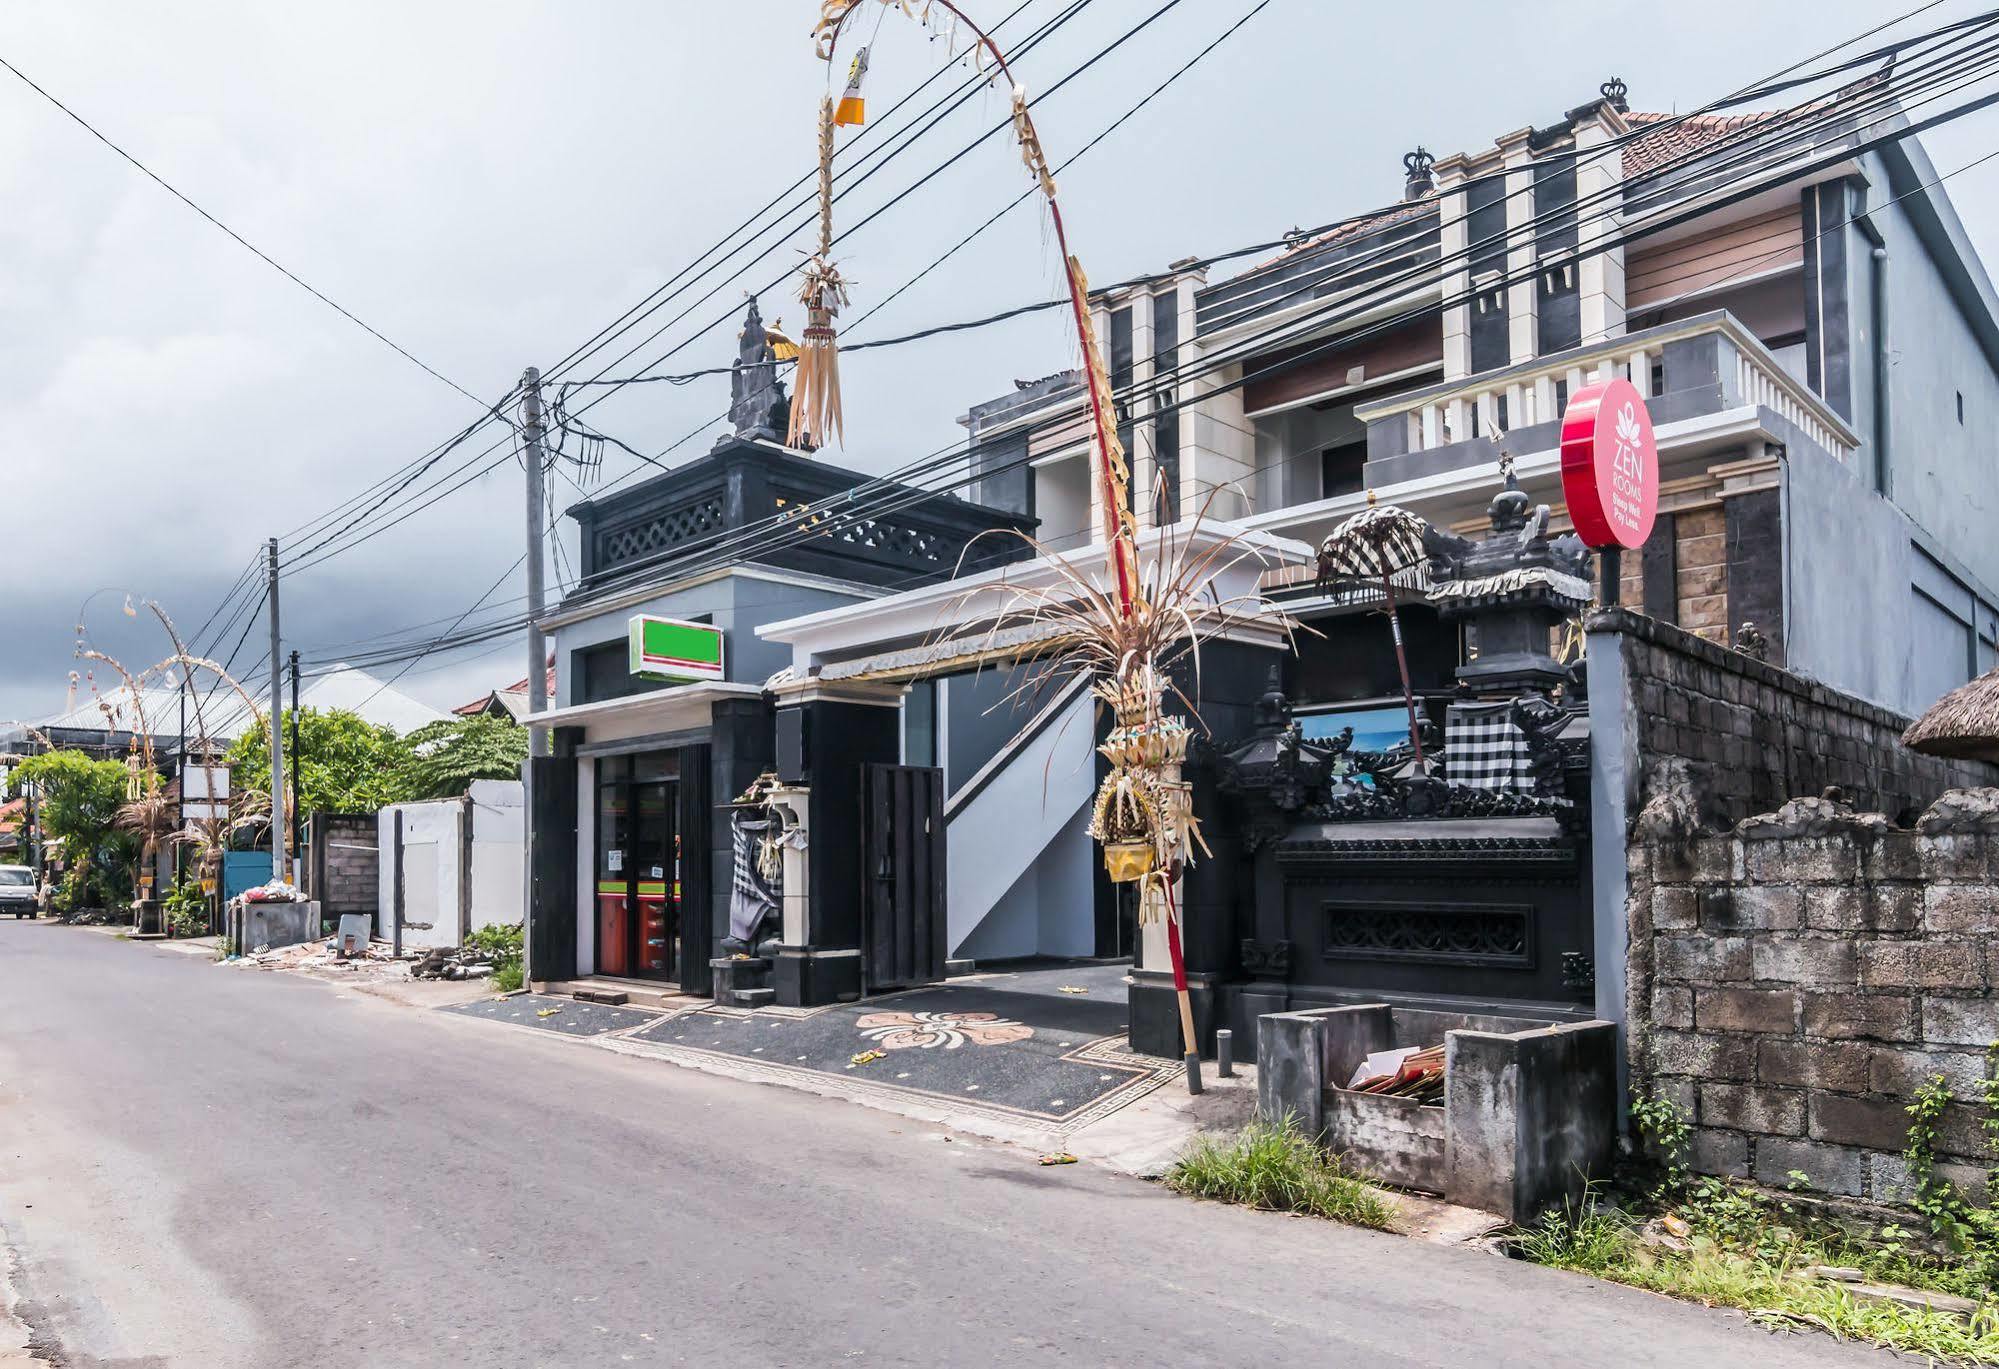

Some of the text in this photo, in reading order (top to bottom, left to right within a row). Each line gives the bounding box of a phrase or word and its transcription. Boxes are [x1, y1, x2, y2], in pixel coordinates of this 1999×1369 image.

[1613, 439, 1642, 483] ZEN
[1613, 471, 1642, 502] ROOMS
[1614, 505, 1624, 525] Pay
